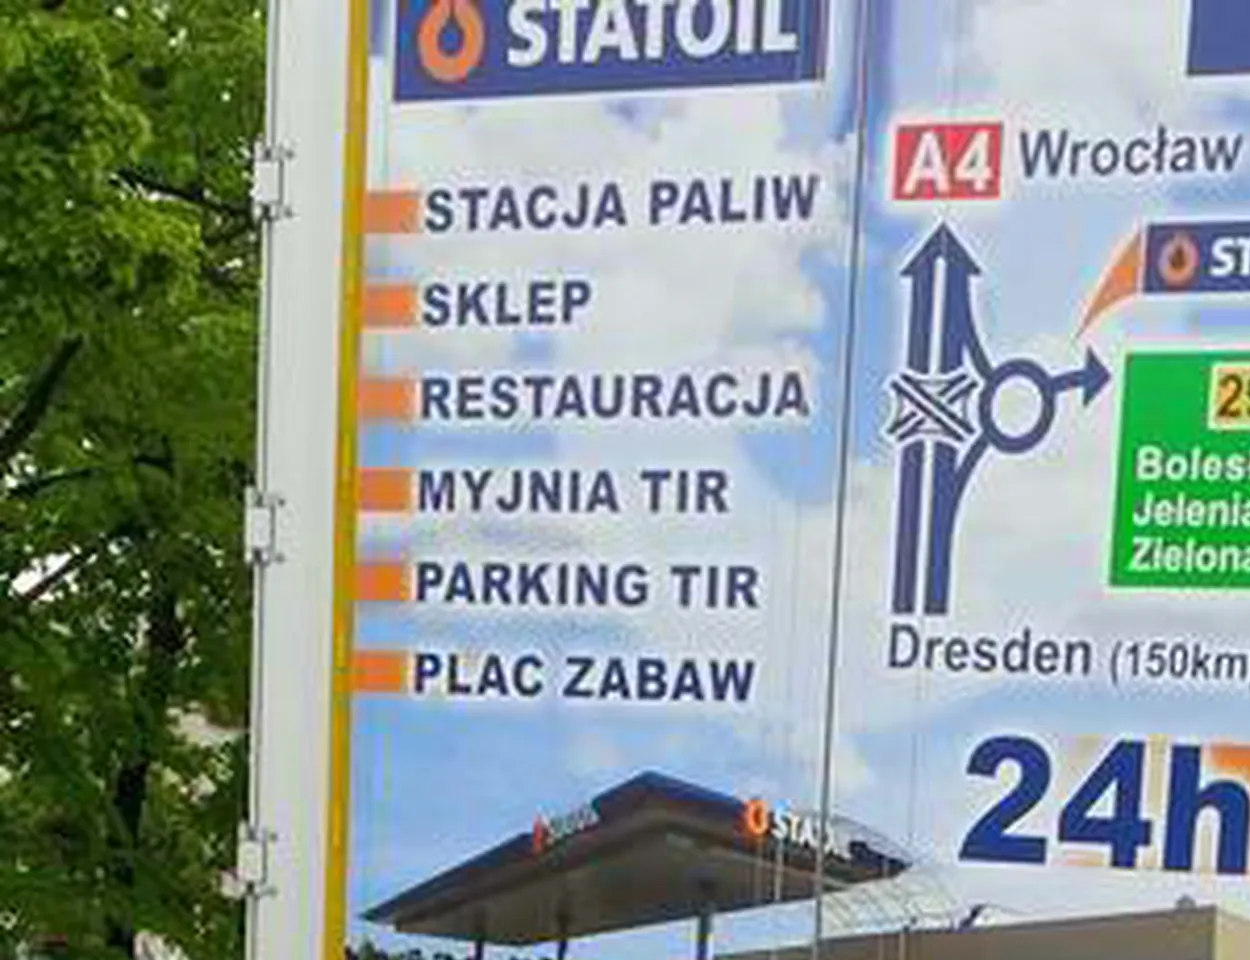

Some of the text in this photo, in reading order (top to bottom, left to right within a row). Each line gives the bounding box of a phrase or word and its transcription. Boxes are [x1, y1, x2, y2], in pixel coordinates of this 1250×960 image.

[506, 0, 799, 67] STATOIL
[902, 130, 993, 196] A4
[1018, 125, 1243, 179] Wrocław
[424, 174, 818, 232] STACJA PALIW
[422, 280, 591, 327] SKLEP
[419, 371, 811, 421] RESTAURACJA
[417, 469, 730, 514] MYJNIA TIR
[415, 561, 760, 609] PARKING TIR
[887, 623, 1092, 676] Dresden
[413, 653, 755, 702] PLAC ZABAW
